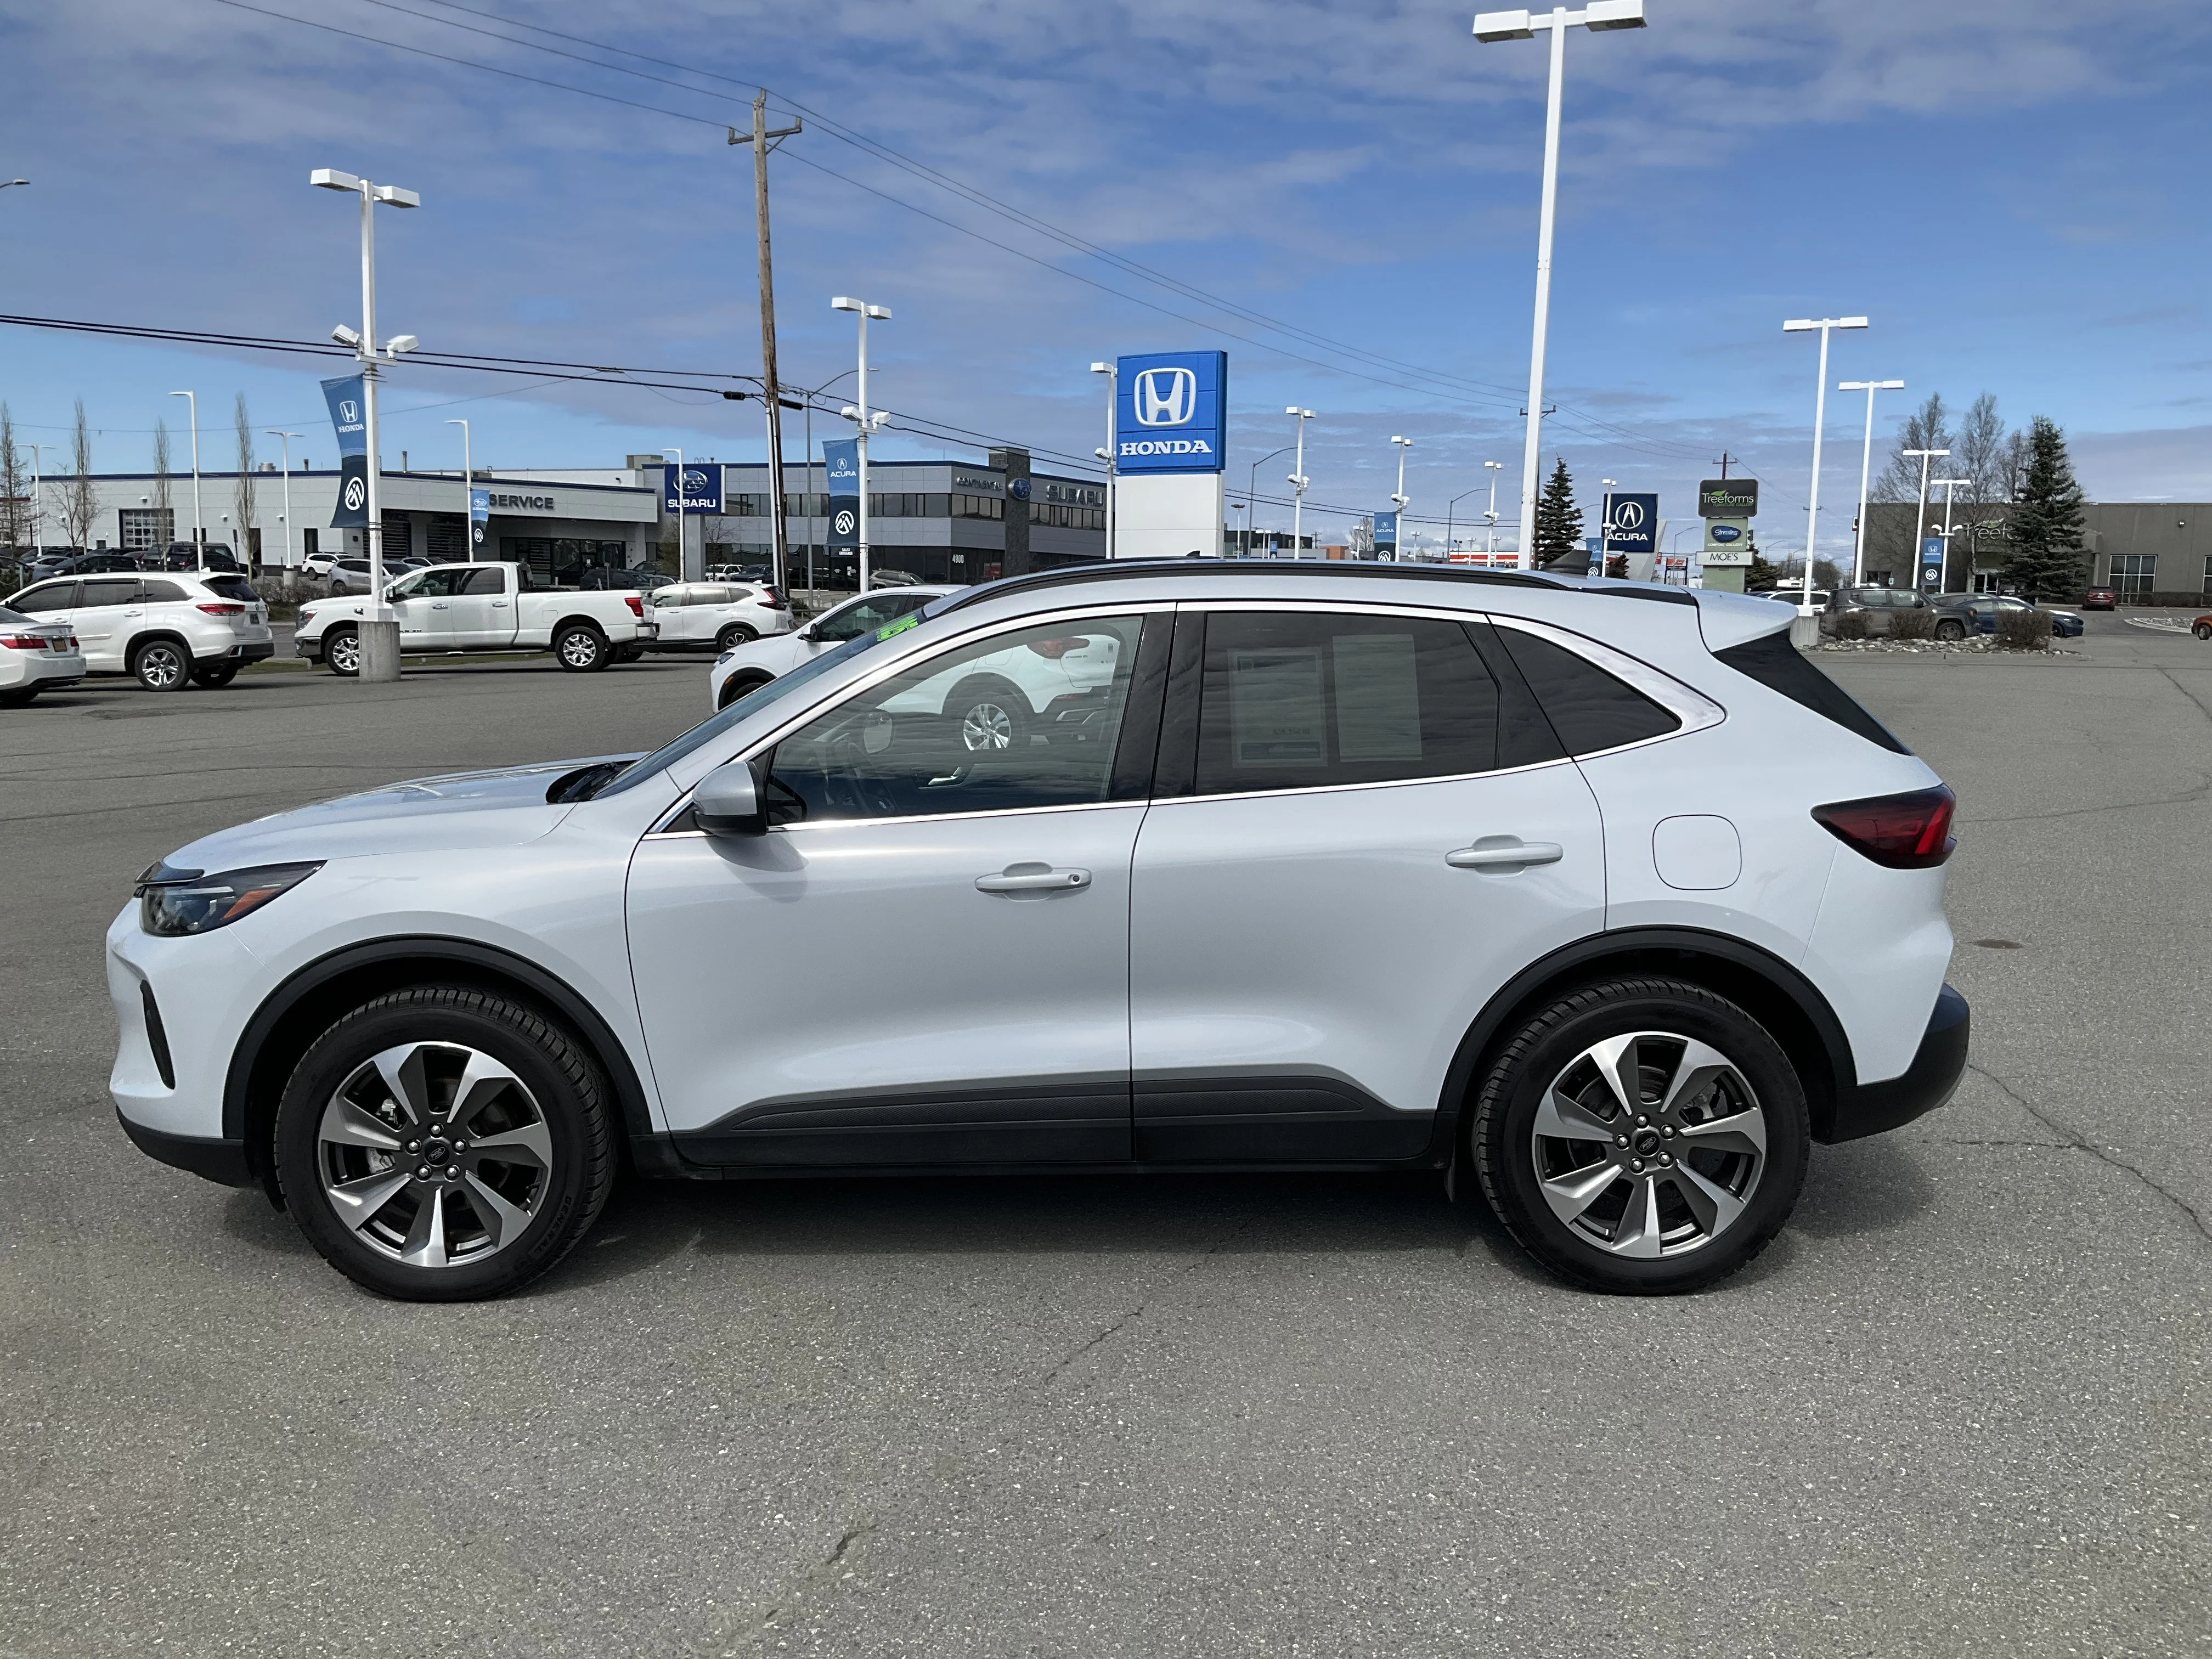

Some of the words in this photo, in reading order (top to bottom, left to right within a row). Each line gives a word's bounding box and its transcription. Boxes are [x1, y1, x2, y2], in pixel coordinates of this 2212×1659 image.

[338, 424, 364, 433] HONDA
[1120, 440, 1212, 456] HONDA
[1047, 485, 1103, 507] SUBARU
[1702, 492, 1754, 503] Treeforms
[489, 494, 554, 510] SERVICE
[668, 499, 716, 507] SUBARU
[952, 554, 964, 563] 4900
[1709, 553, 1739, 561] MOE'S
[533, 1195, 572, 1253] GENERAL
